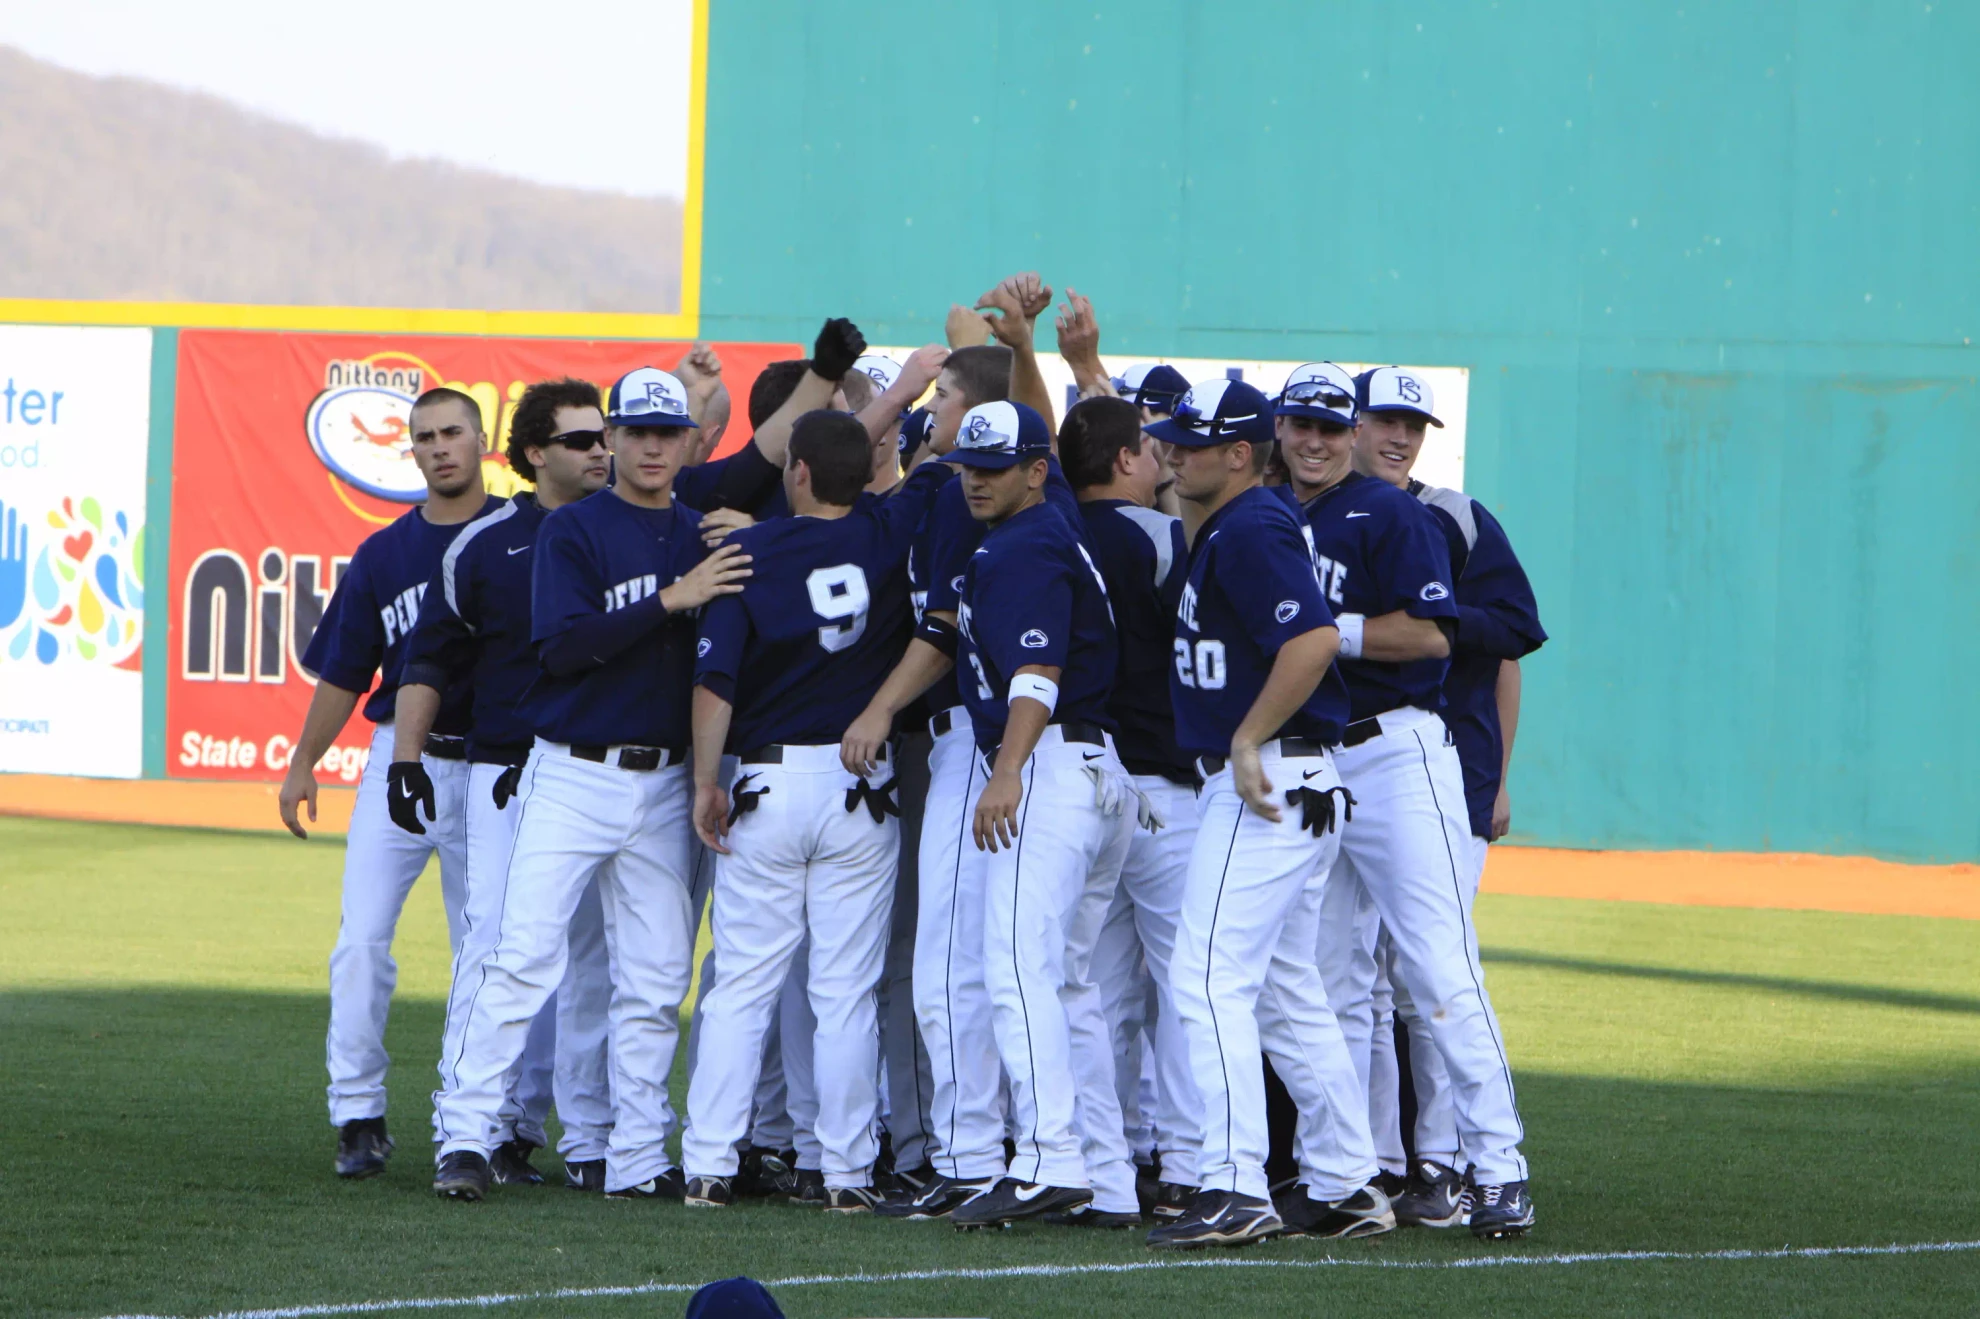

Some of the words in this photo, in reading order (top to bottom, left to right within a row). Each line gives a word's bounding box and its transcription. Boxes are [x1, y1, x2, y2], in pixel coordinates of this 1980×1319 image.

[805, 562, 870, 654] 9
[1174, 637, 1227, 690] 20
[179, 730, 257, 768] State
